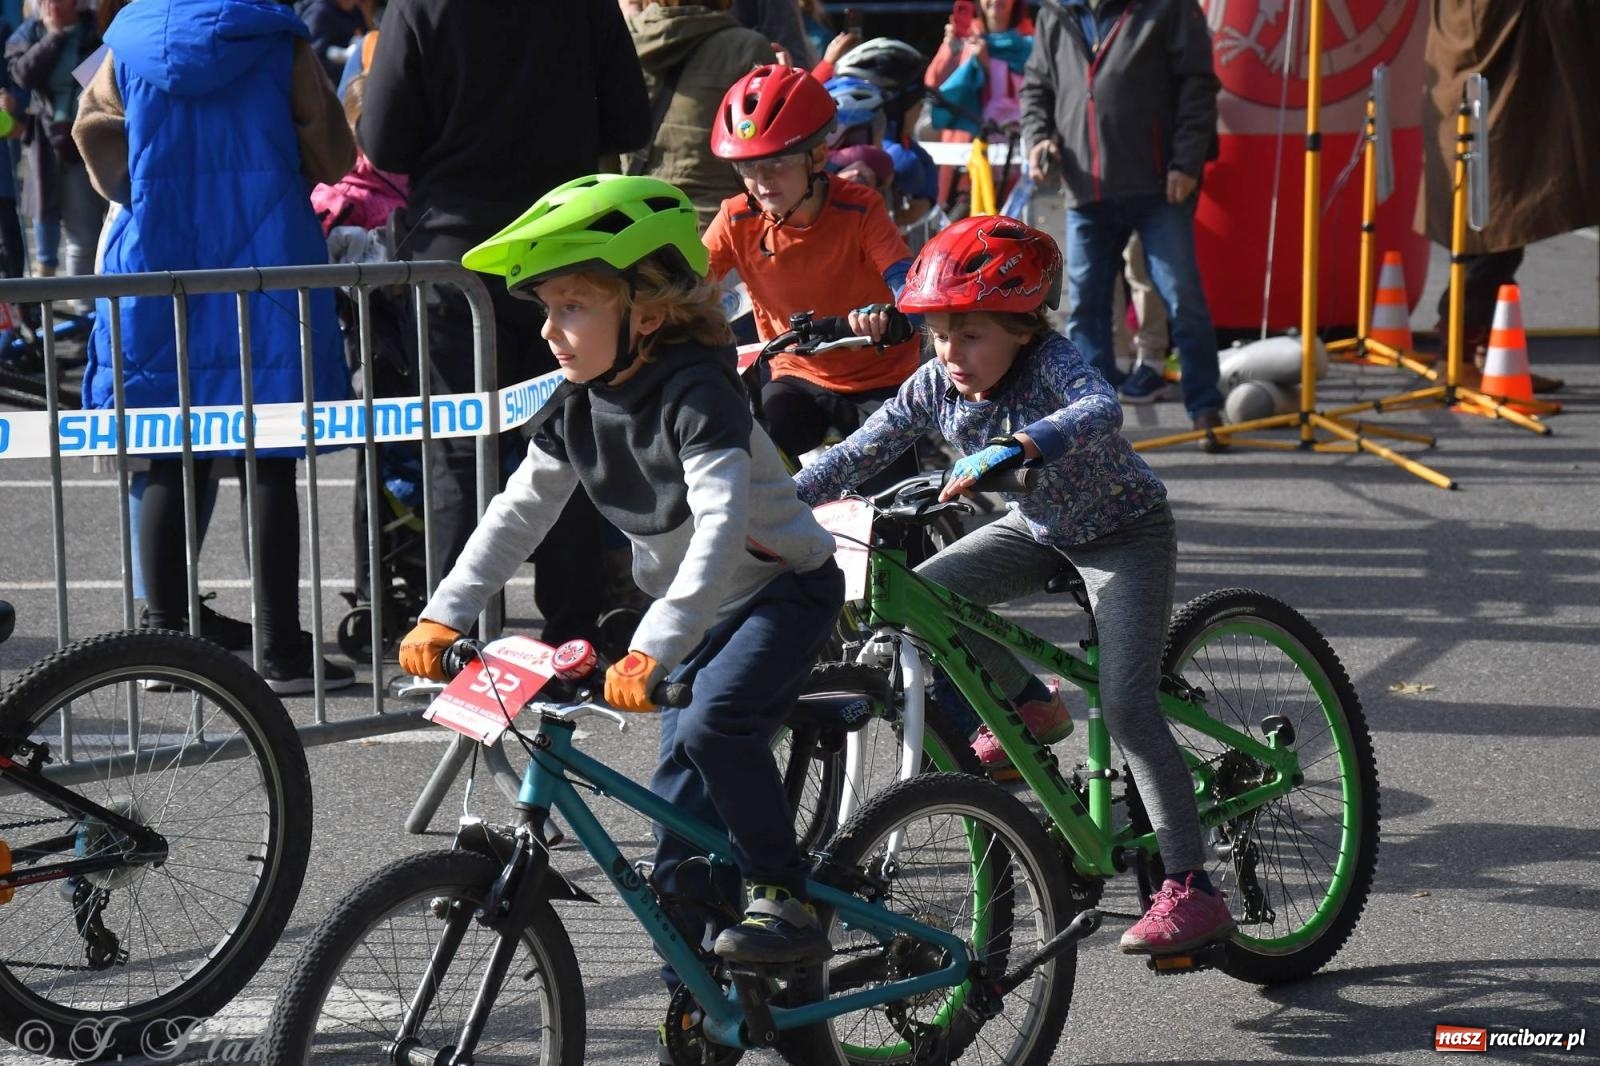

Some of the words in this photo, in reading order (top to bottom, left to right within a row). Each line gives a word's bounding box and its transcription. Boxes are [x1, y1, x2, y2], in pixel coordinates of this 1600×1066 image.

[999, 253, 1024, 275] MET
[59, 411, 256, 450] SHIMANO
[301, 399, 483, 440] SHIMANO
[469, 666, 521, 702] 92
